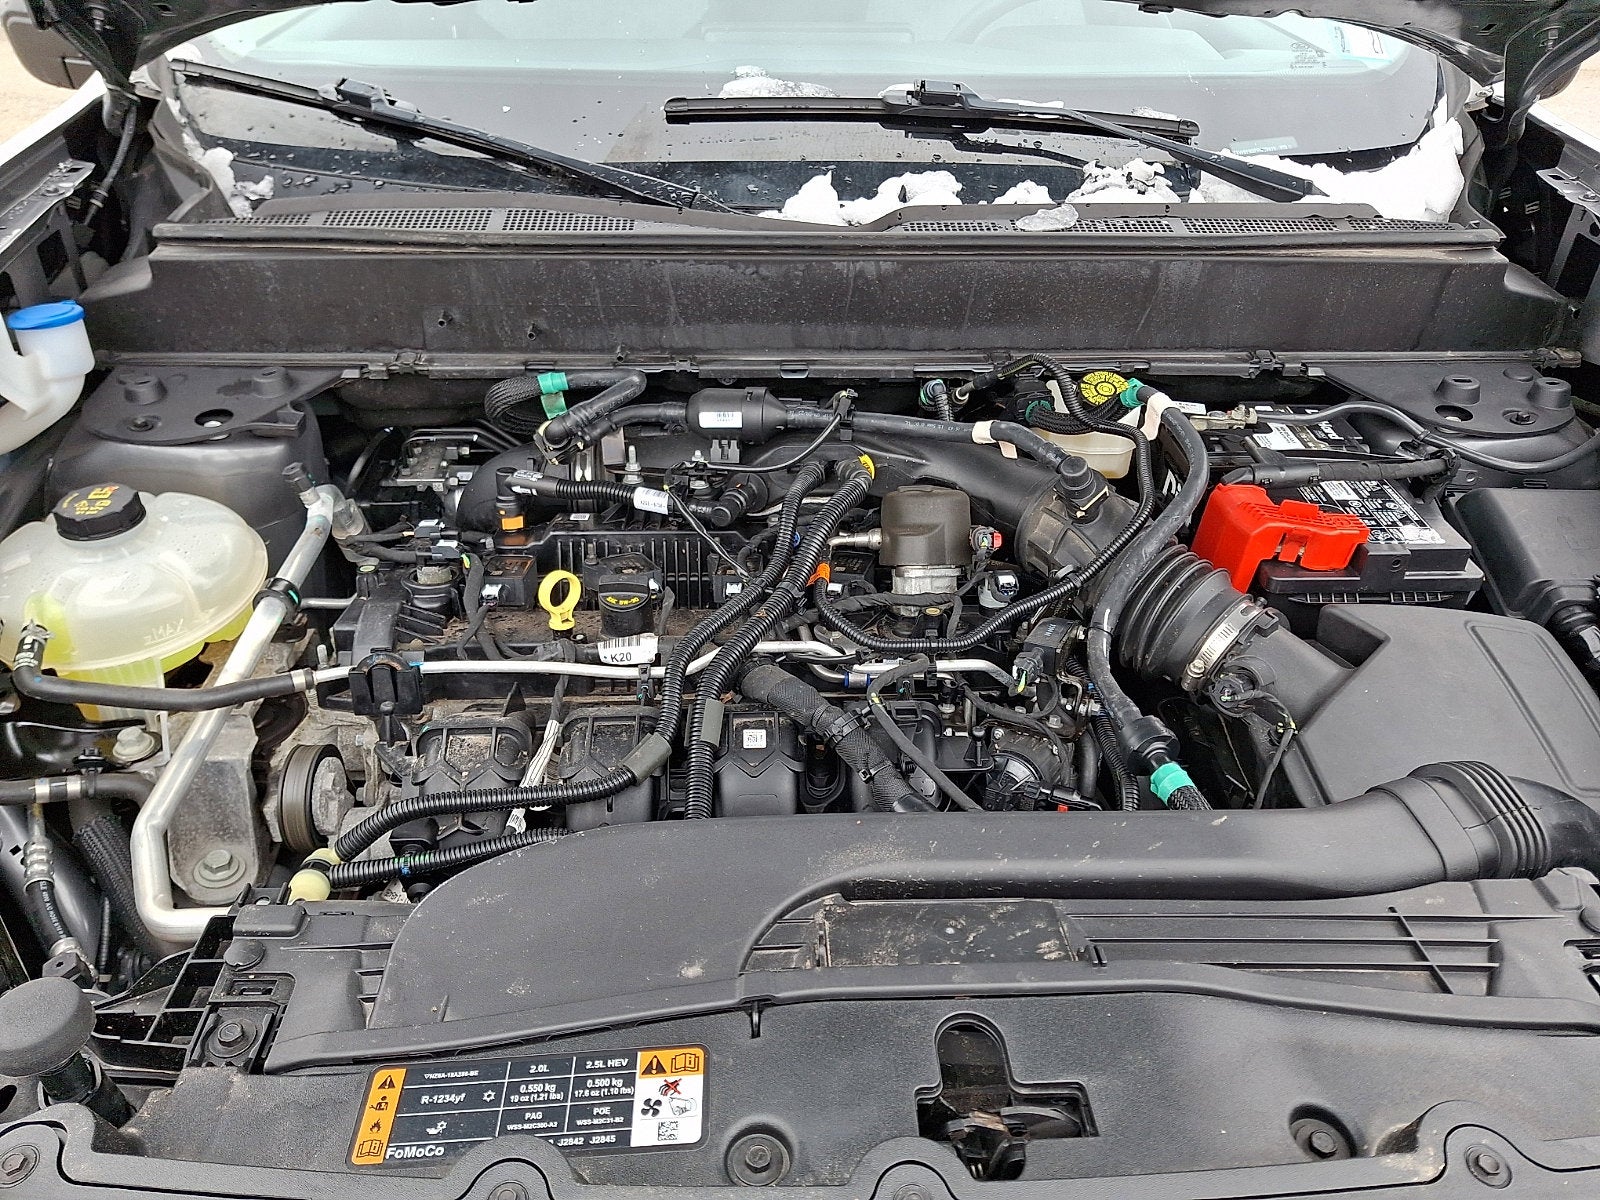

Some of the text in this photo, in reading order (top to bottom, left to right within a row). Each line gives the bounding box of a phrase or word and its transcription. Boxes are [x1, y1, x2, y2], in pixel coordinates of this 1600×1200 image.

[610, 652, 632, 663] K20
[529, 1064, 550, 1074] 2.0L
[585, 1058, 629, 1069] 2.5L HEV
[520, 1083, 556, 1093] 0.550 kg
[587, 1077, 623, 1088] 0.500 kg
[530, 1093, 548, 1102] (1.21
[549, 1091, 563, 1101] lbs)
[574, 1089, 590, 1098] 17.6
[590, 1089, 600, 1097] oz
[620, 1086, 634, 1096] lbs)
[420, 1093, 466, 1105] R-1234yf
[525, 1112, 543, 1120] PAG
[593, 1107, 611, 1116] POE
[557, 1137, 584, 1146] J2842
[589, 1135, 616, 1144] J2845
[385, 1145, 445, 1160] FoMoCo
